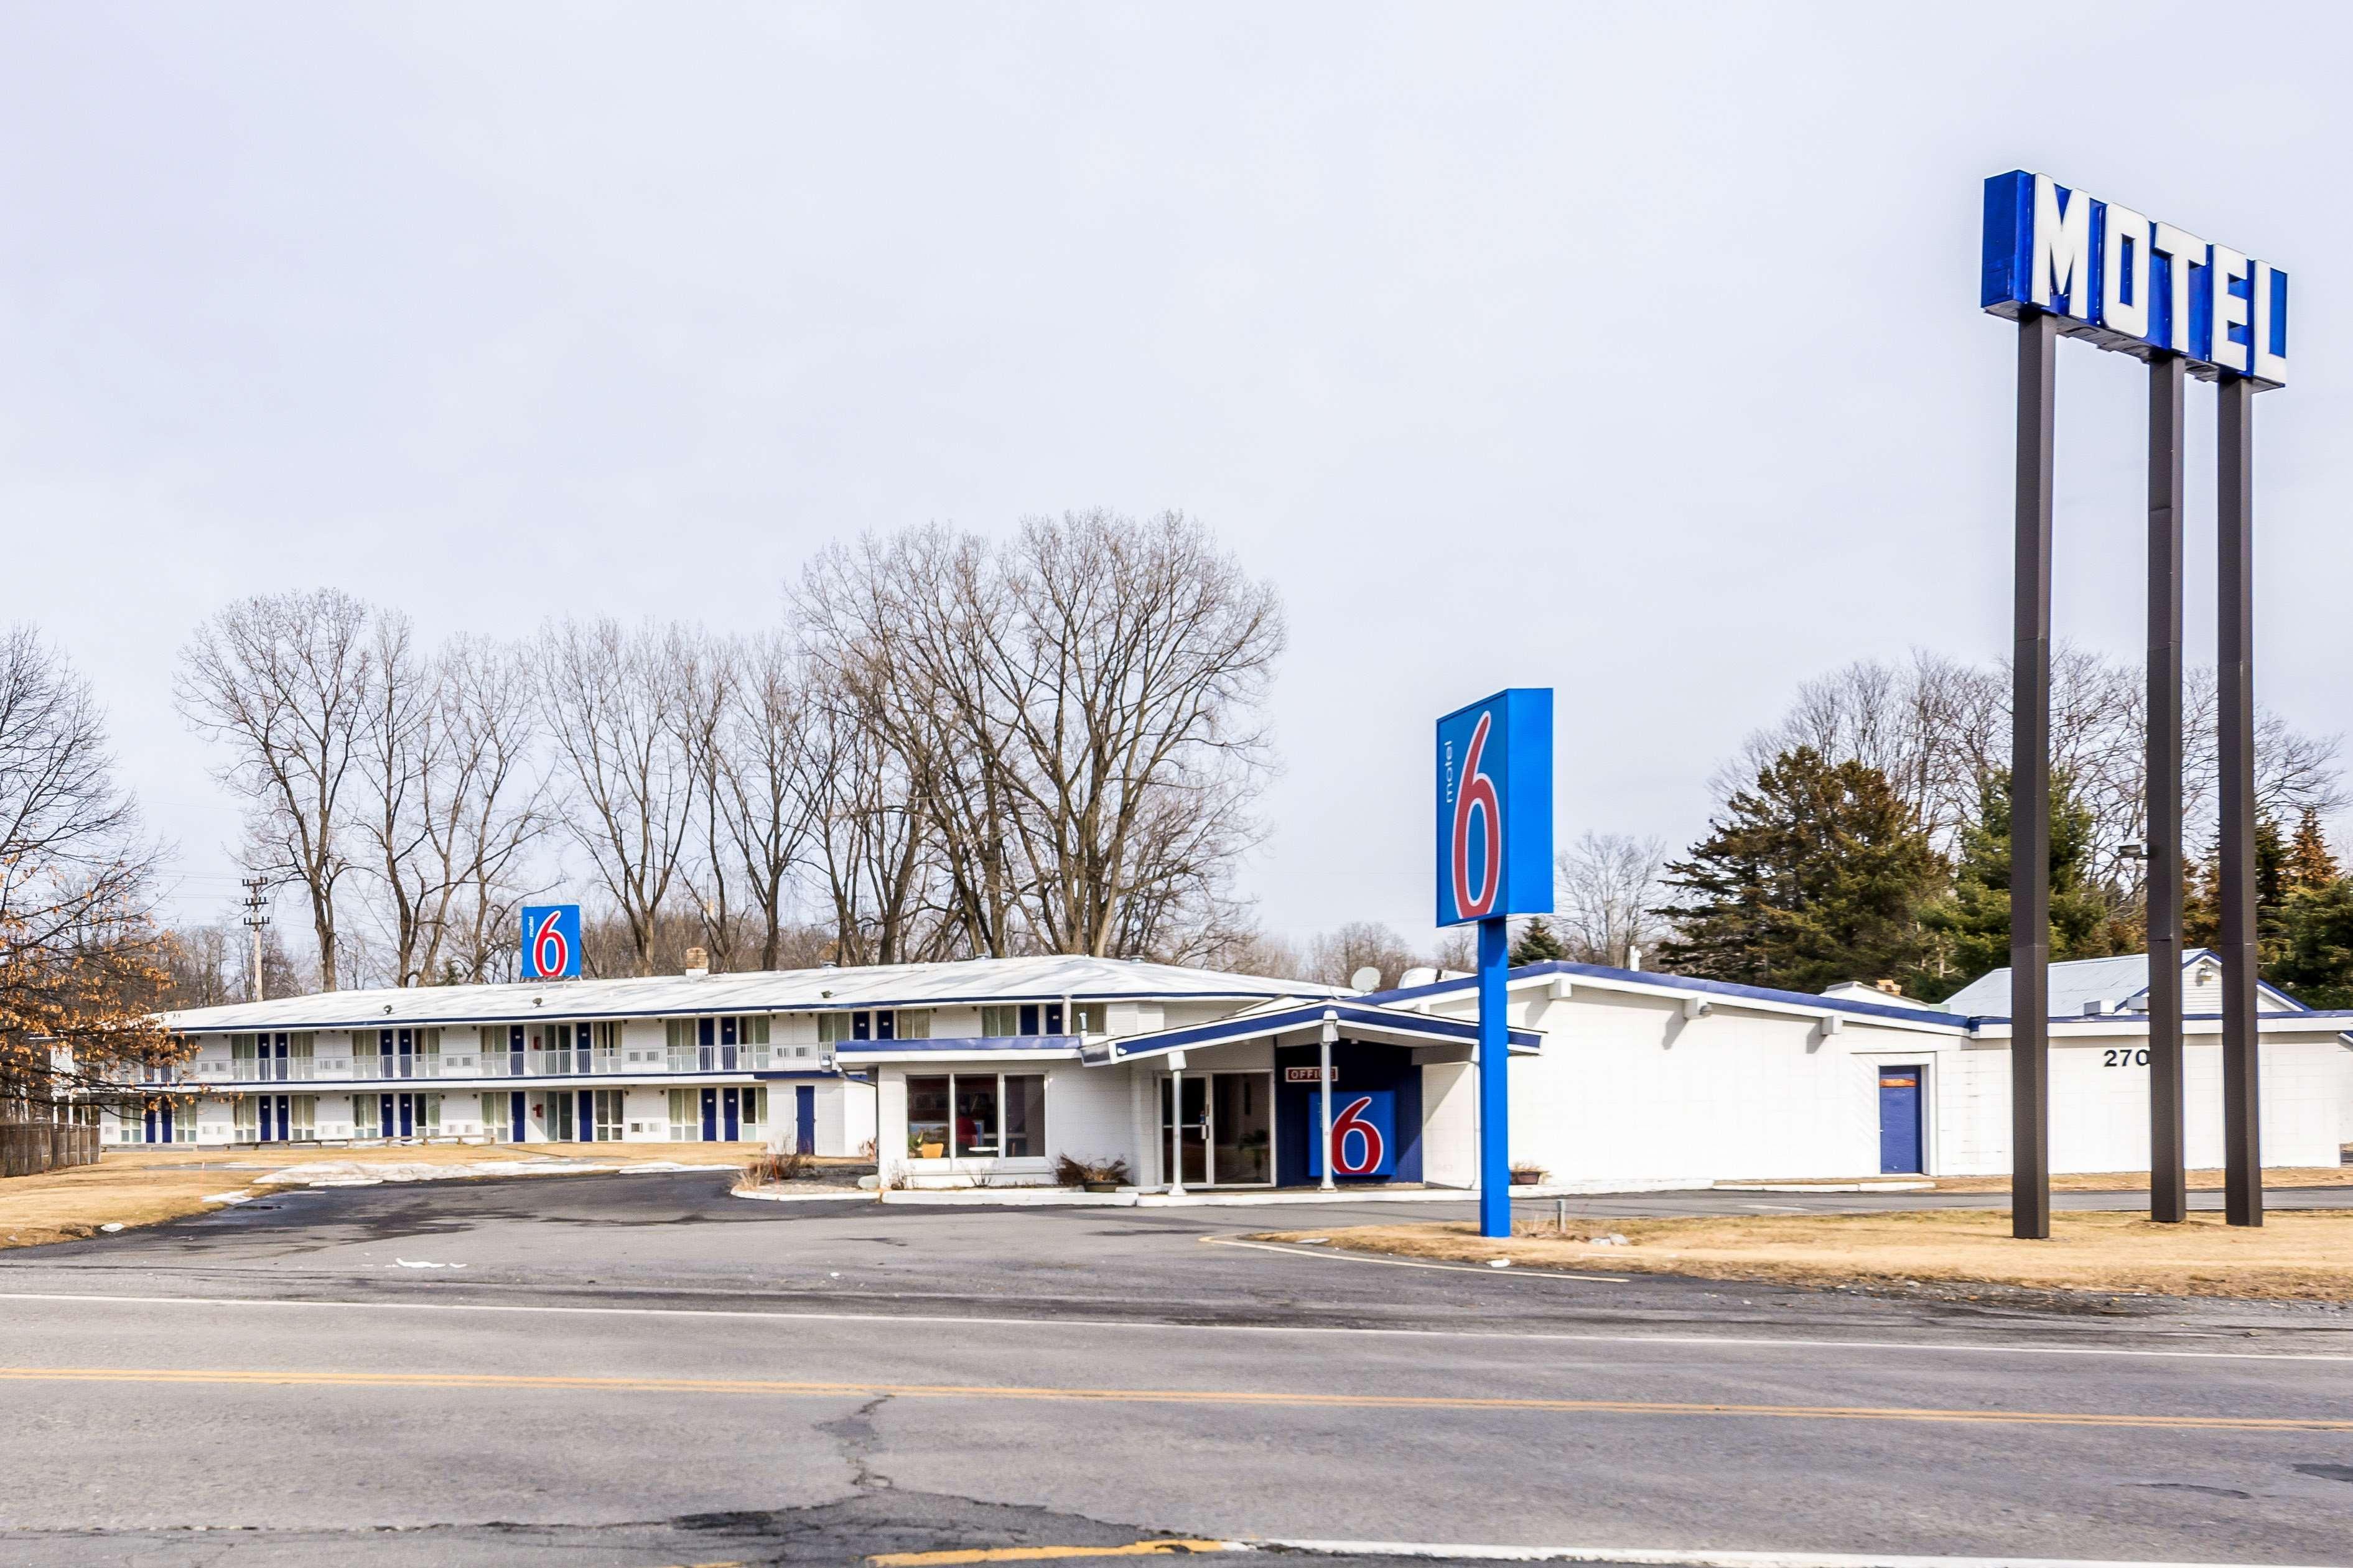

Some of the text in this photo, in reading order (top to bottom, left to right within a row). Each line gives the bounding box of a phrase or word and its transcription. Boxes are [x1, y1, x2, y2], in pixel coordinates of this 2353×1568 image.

[2032, 172, 2286, 384] MOTEL
[1444, 741, 1453, 803] motel
[1451, 710, 1501, 919] 6
[533, 911, 568, 977] 6
[1331, 1096, 1384, 1174] 6
